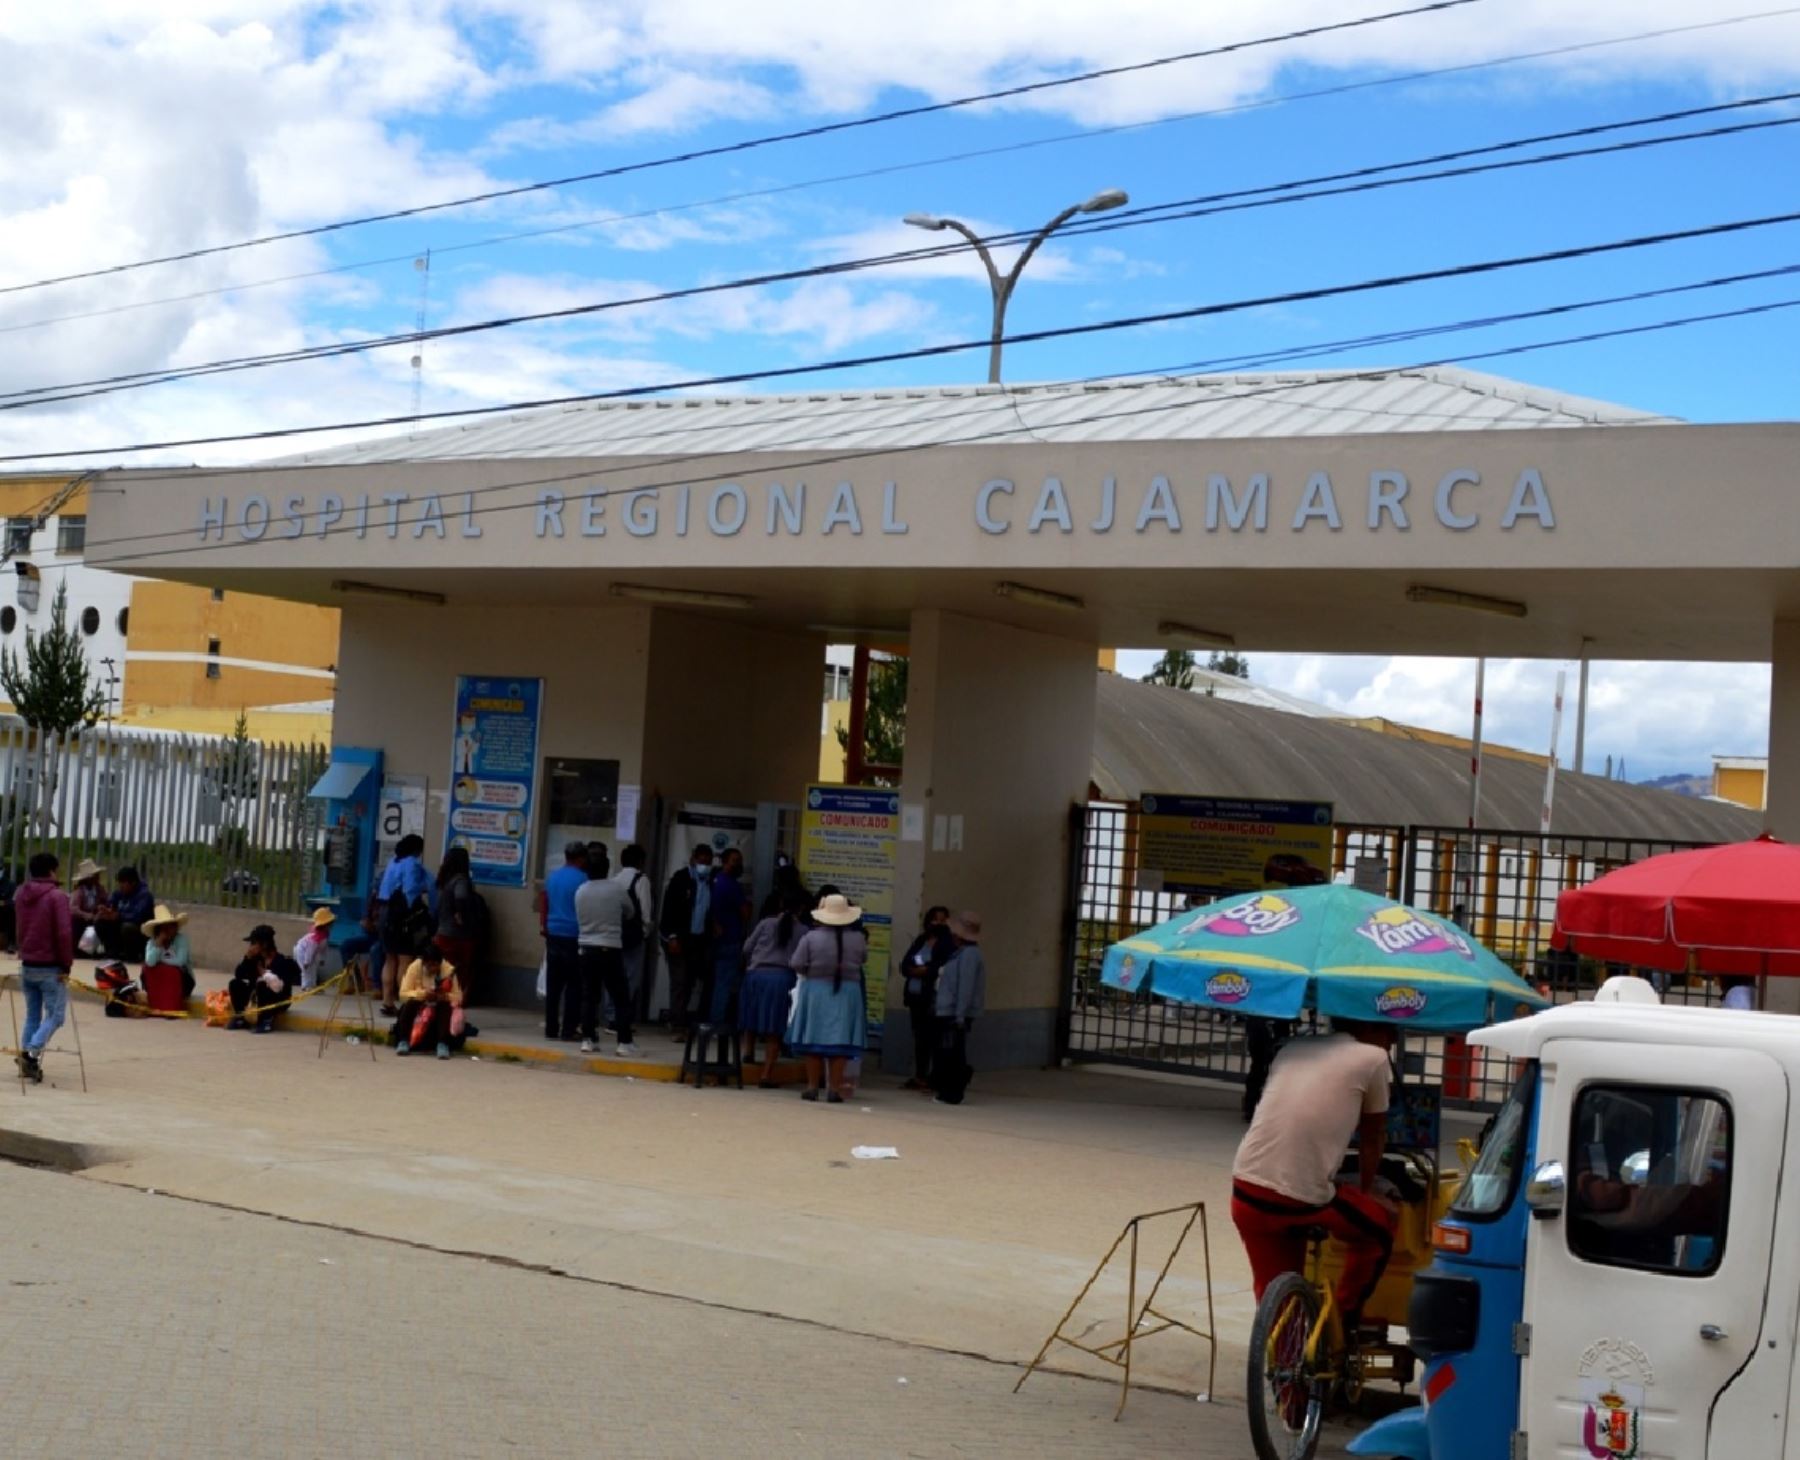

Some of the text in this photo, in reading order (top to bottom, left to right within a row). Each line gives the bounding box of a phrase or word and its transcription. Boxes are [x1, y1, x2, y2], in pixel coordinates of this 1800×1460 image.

[198, 468, 1556, 541] HOSPITAL REGIONAL CAJAMARCA
[384, 803, 402, 835] a
[820, 813, 889, 828] COMUNICADO
[1190, 820, 1276, 836] COMUNICADO
